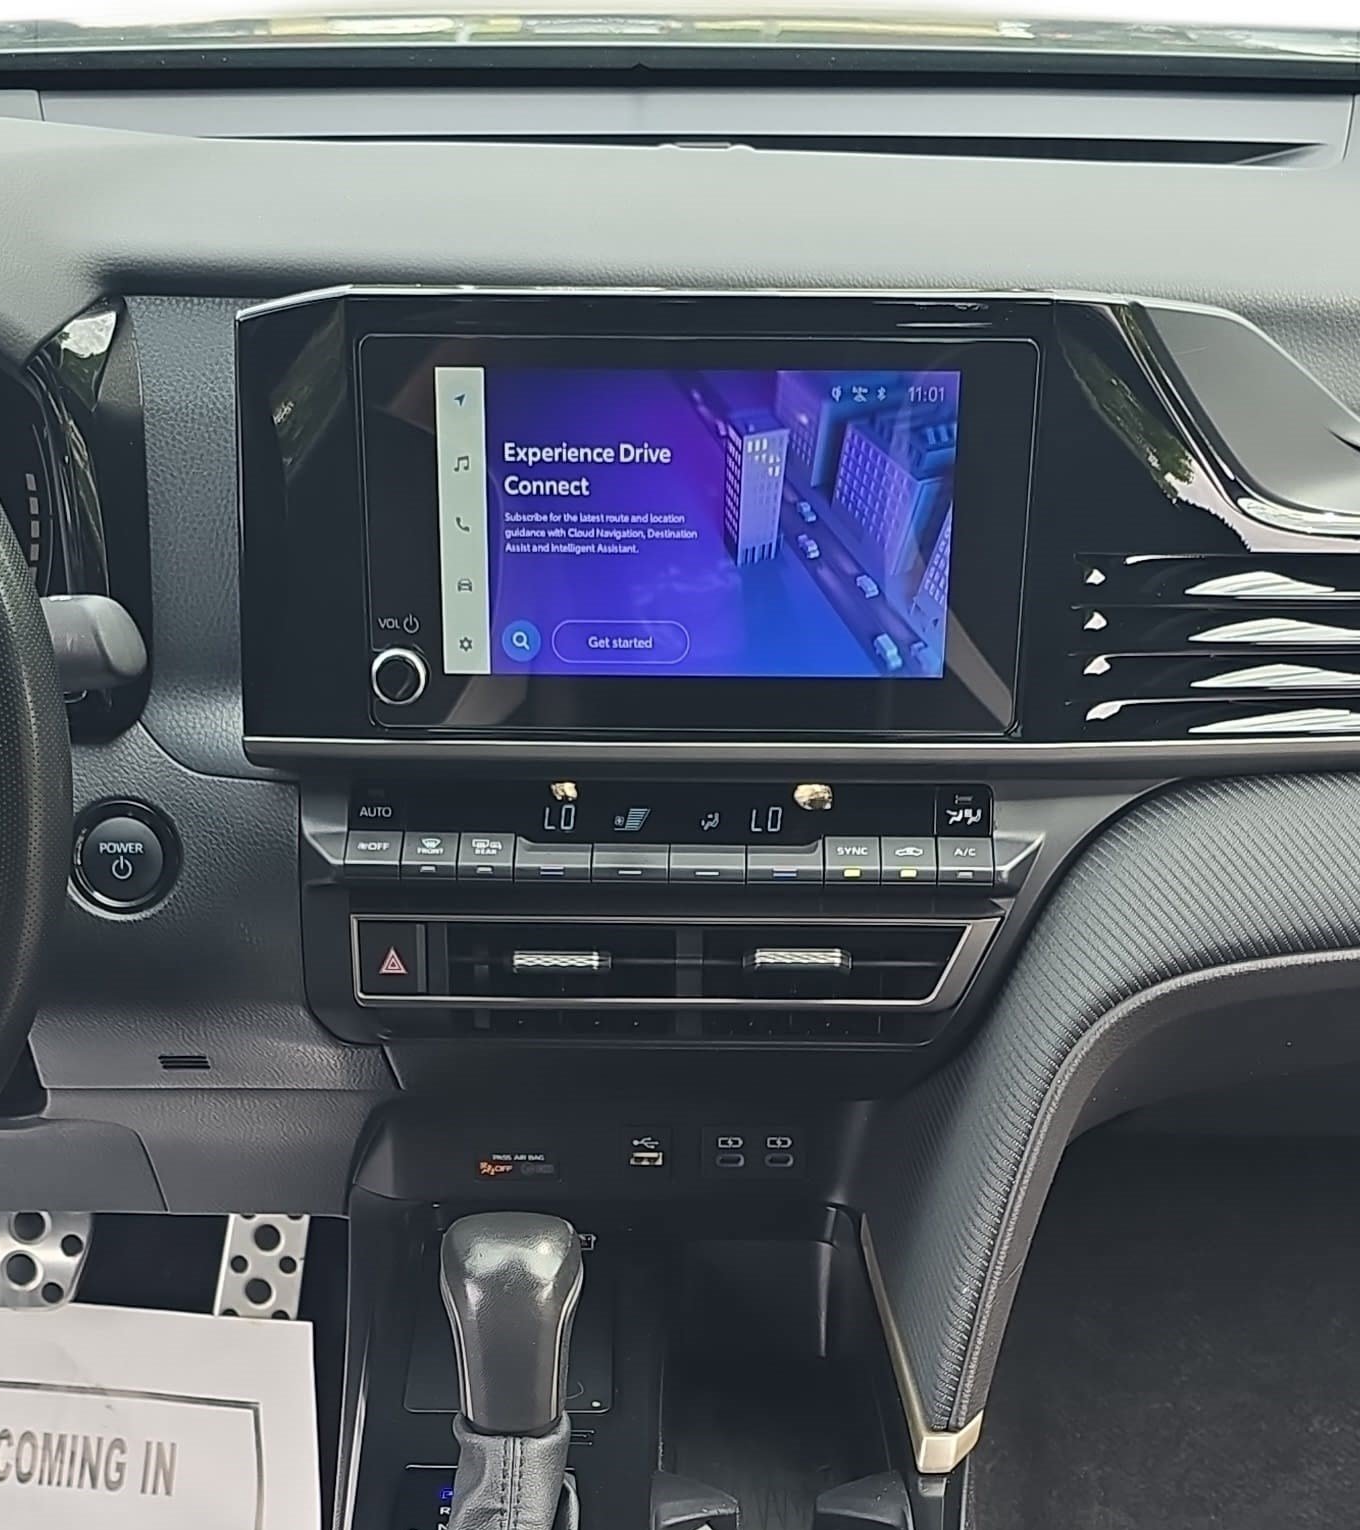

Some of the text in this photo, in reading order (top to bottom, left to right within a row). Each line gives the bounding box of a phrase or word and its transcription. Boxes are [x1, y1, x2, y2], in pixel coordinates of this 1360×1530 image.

[908, 386, 944, 402] 11:01
[504, 442, 671, 466] Experience Drive
[504, 476, 590, 496] Connect
[505, 512, 685, 524] Subscribe for the latest route and location
[505, 528, 698, 541] guidance with Cloud Navigation, Destination
[505, 543, 640, 555] Assist and Intelligent Assistant.
[377, 617, 401, 629] VOL
[588, 636, 653, 649] Get started
[359, 806, 392, 818] AUTO
[99, 842, 144, 854] POWER
[367, 842, 390, 851] OFF
[836, 847, 869, 856] SYNC
[954, 847, 977, 856] A/C
[495, 1164, 513, 1172] OFF
[140, 1440, 178, 1496] IN
[439, 1506, 451, 1515] R
